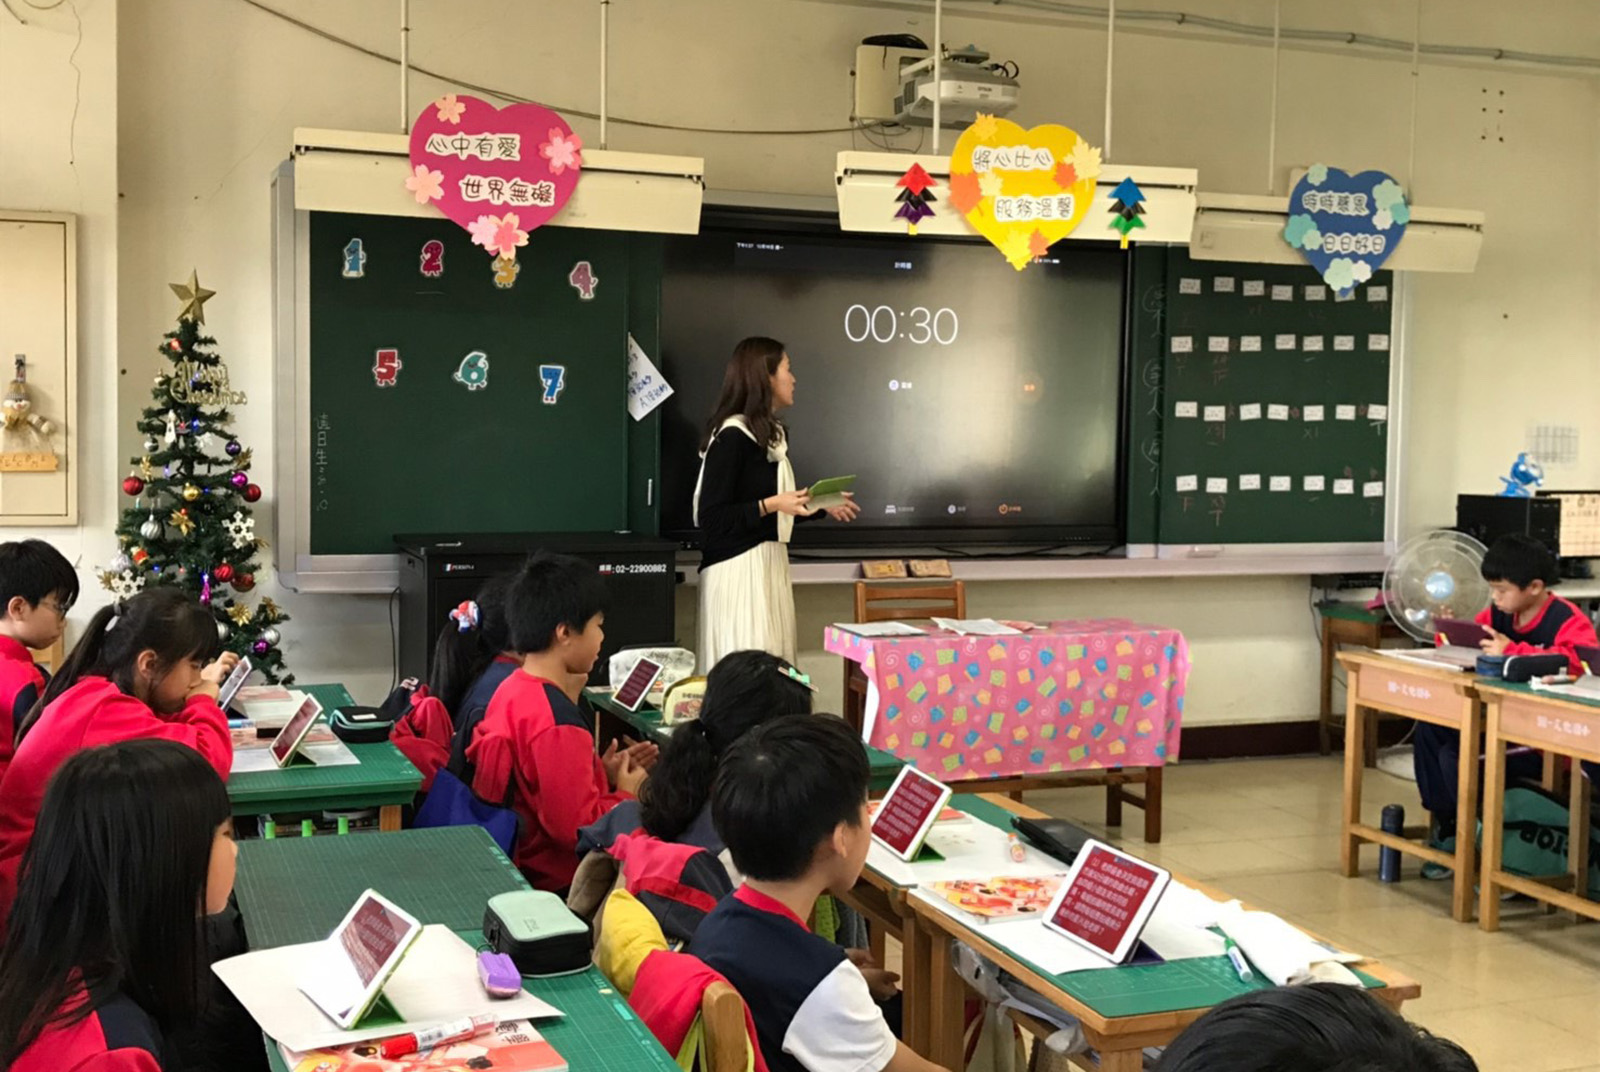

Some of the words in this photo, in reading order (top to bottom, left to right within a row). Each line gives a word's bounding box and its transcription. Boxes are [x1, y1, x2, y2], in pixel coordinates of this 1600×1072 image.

[427, 135, 517, 158] 心中有愛
[974, 148, 1051, 169] 將心比心
[462, 178, 552, 203] 世界無礙
[1324, 235, 1383, 253] 日日好日
[844, 304, 959, 345] 00:30
